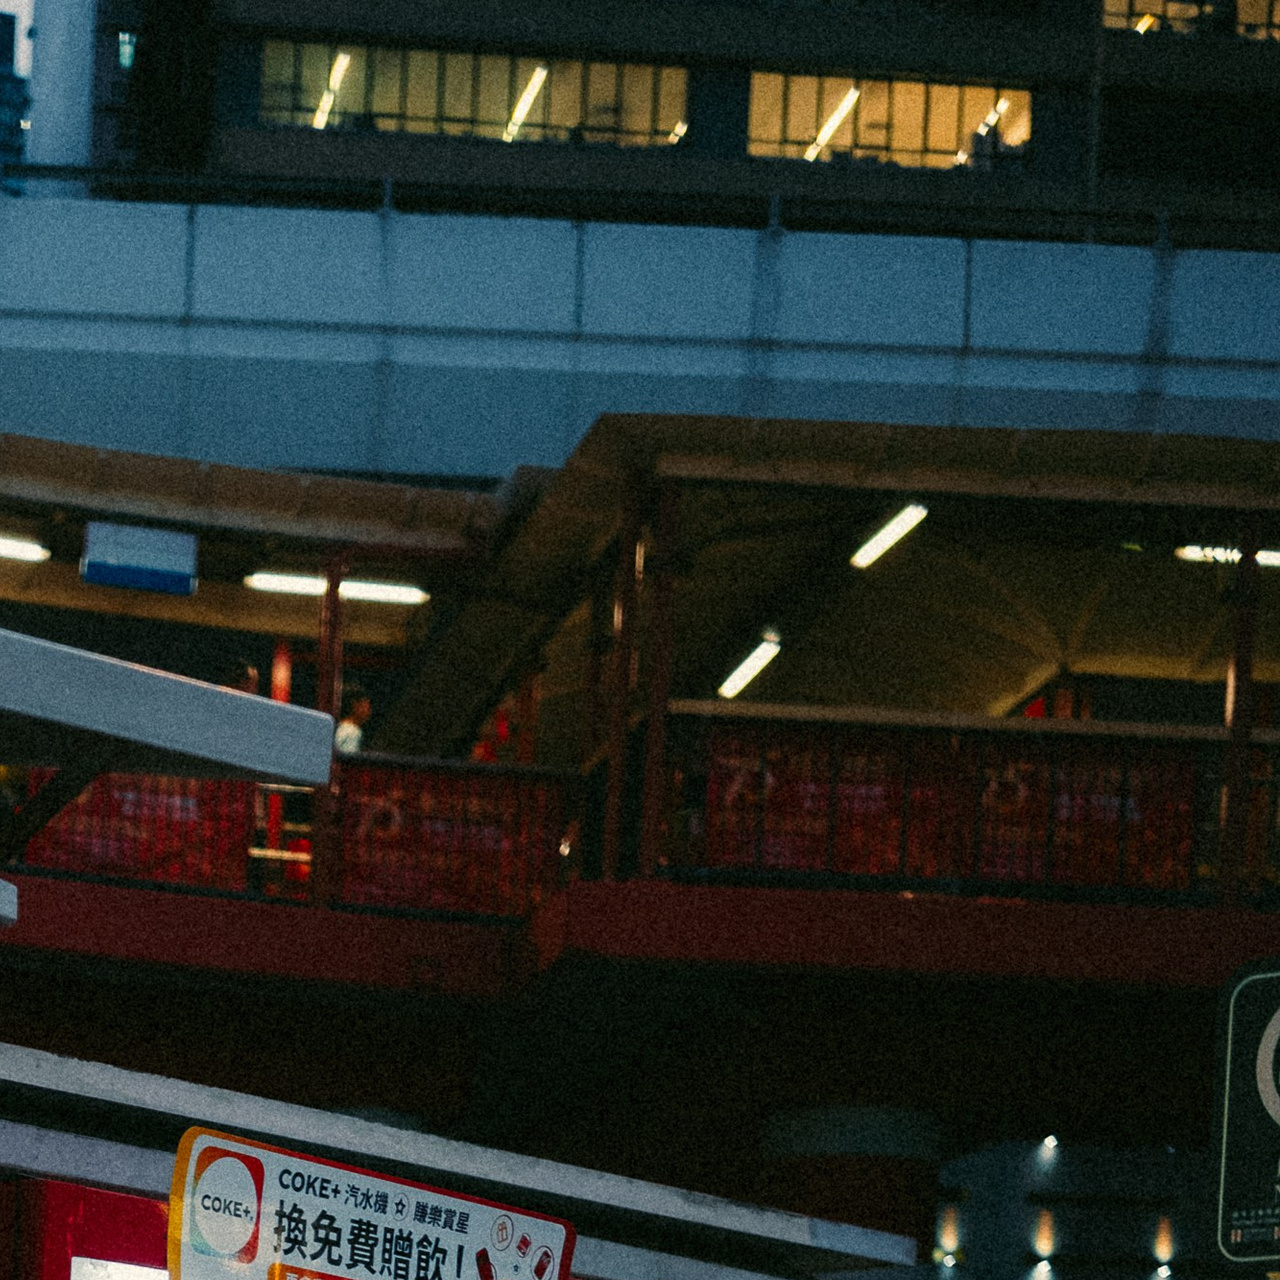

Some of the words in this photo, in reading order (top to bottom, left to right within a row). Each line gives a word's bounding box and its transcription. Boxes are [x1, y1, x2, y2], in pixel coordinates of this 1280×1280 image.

[200, 1193, 251, 1219] COKE+
[278, 1168, 341, 1200] COKE+
[343, 1182, 390, 1214] 汽水機
[412, 1200, 471, 1235] 賺樂賞星
